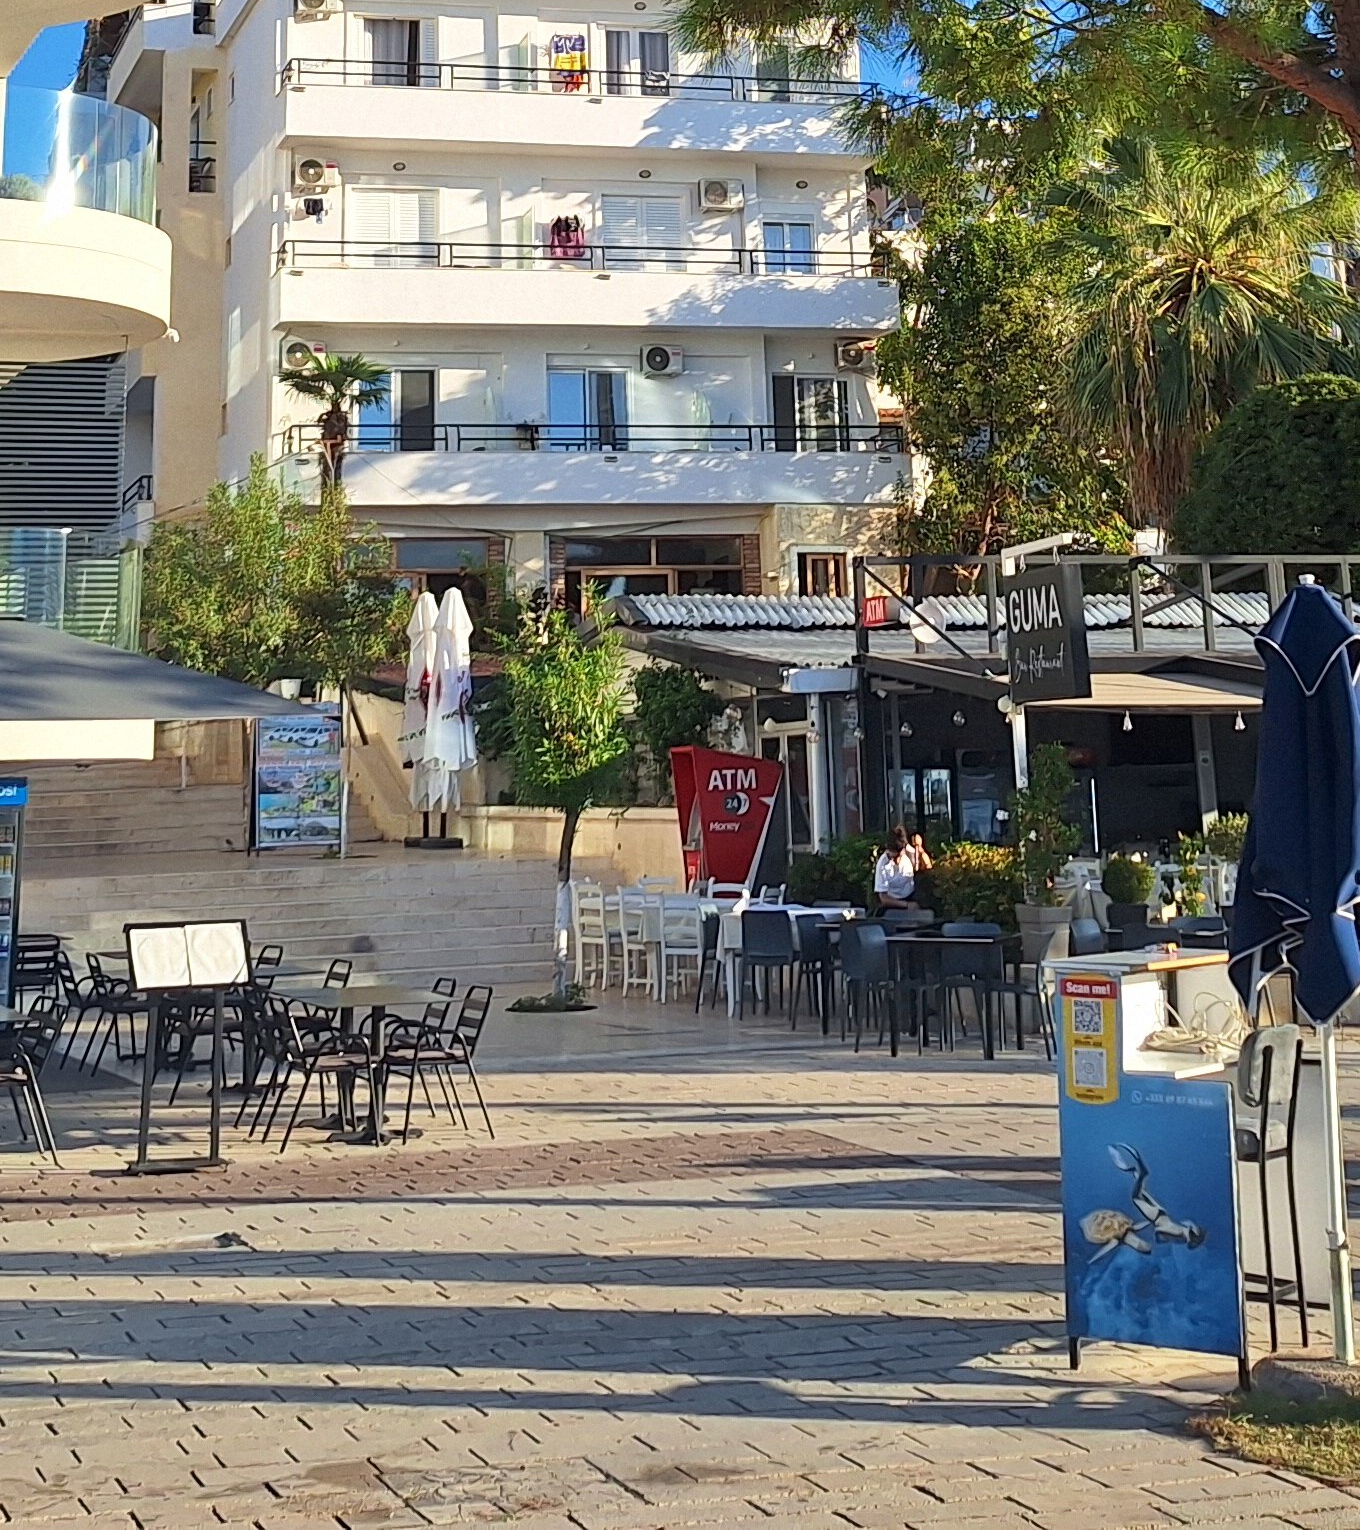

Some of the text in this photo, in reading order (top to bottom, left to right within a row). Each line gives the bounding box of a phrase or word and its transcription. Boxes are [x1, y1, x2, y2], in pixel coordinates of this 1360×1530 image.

[866, 598, 884, 622] ATM
[1009, 583, 1063, 633] GUMA
[708, 768, 757, 791] ATM
[1065, 981, 1111, 995] Scan me!
